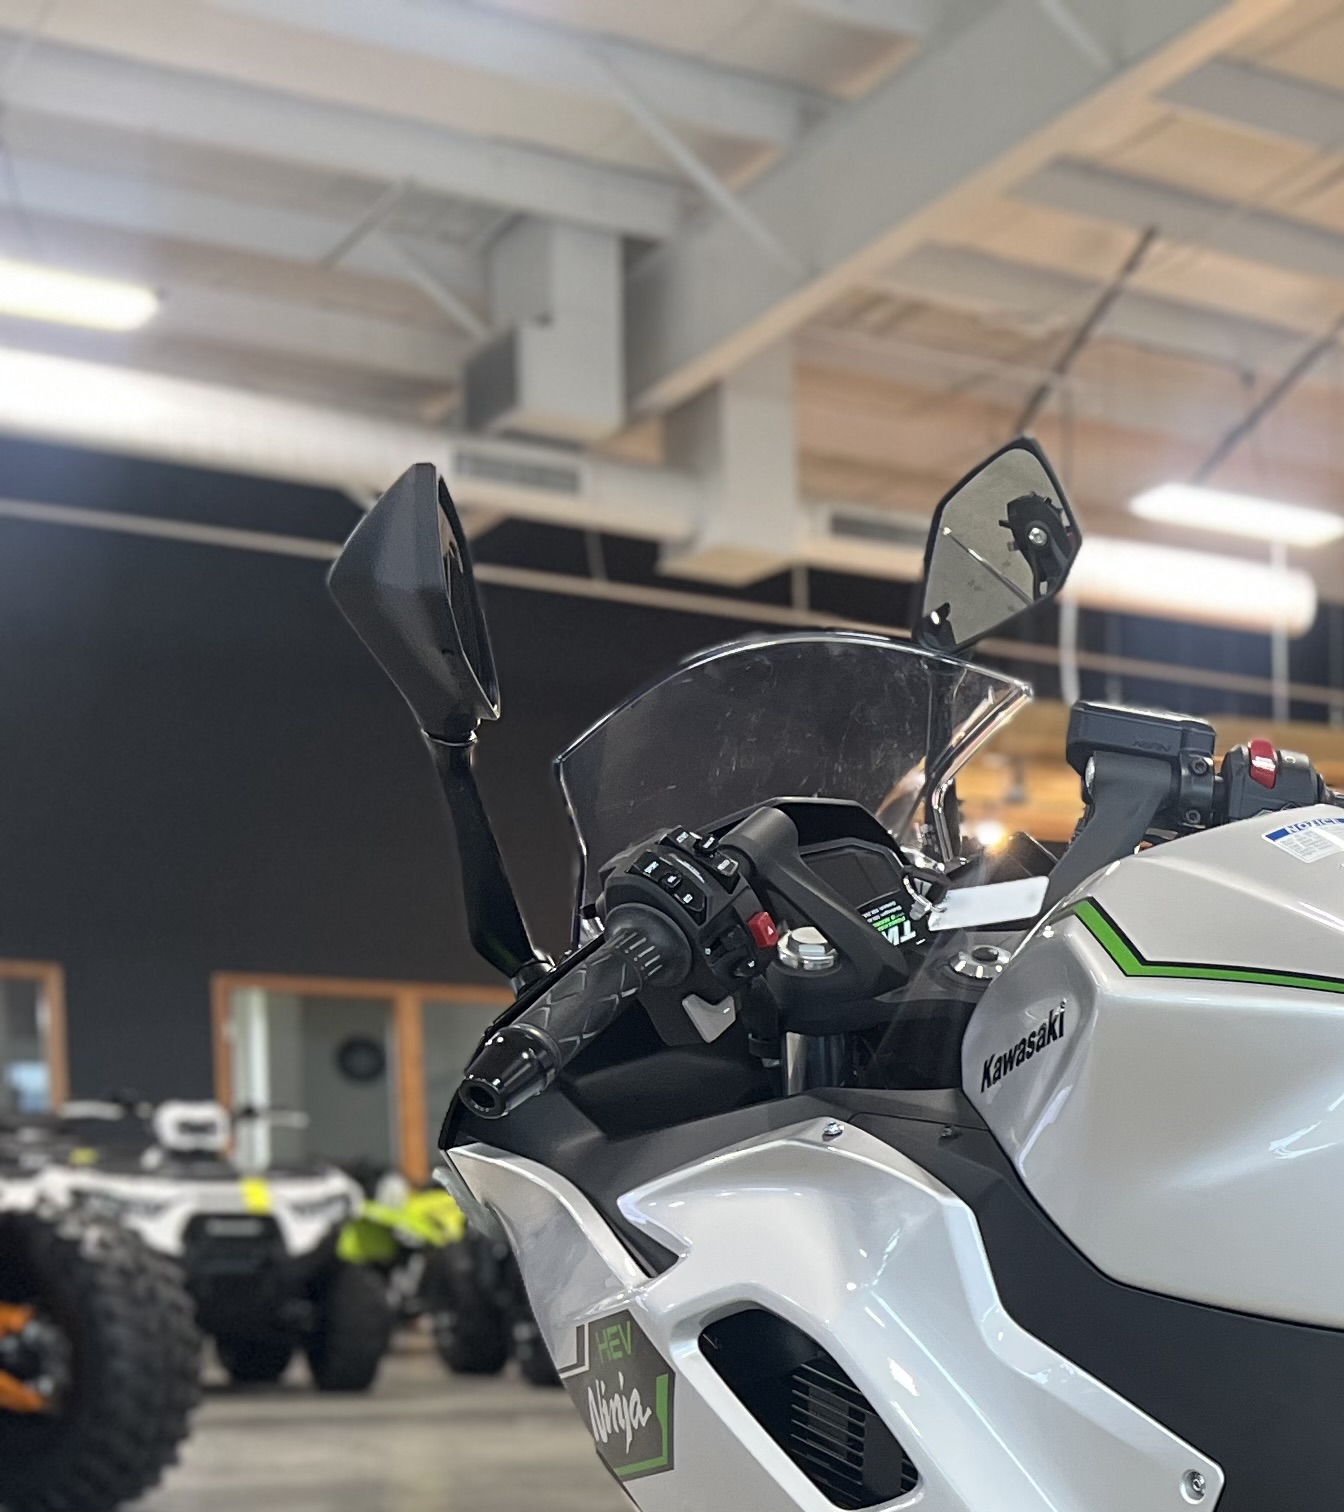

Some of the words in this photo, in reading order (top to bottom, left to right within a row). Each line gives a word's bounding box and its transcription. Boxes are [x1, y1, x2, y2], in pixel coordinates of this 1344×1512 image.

[981, 999, 1067, 1093] Kawasaki
[595, 1320, 632, 1363] HEV
[587, 1371, 652, 1454] Ninja
